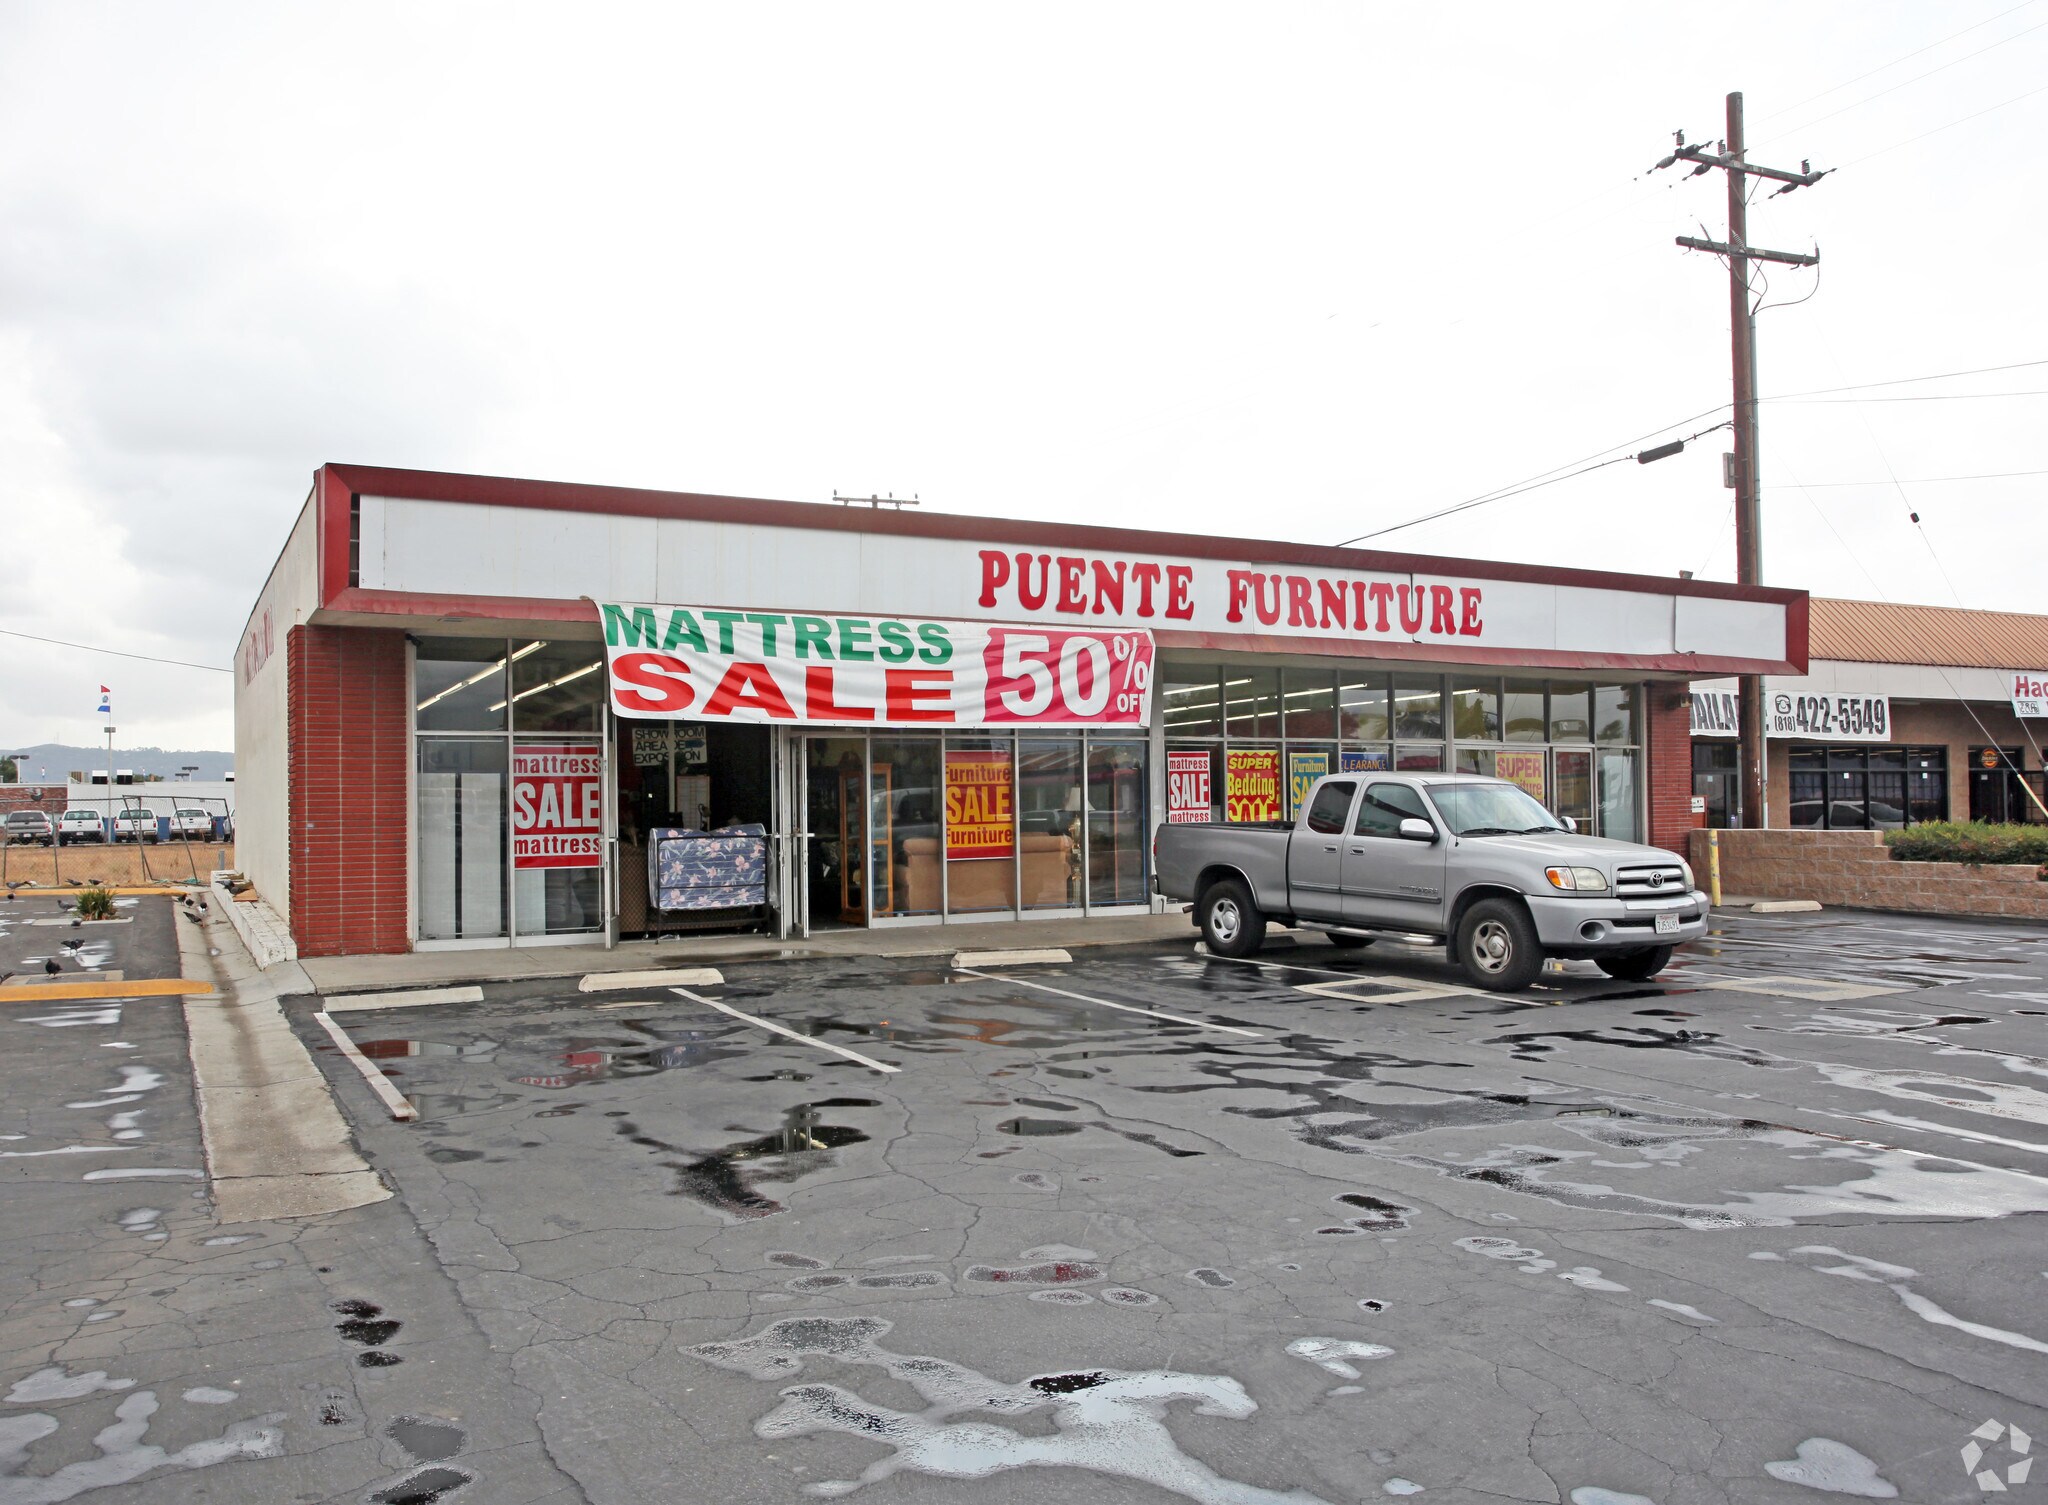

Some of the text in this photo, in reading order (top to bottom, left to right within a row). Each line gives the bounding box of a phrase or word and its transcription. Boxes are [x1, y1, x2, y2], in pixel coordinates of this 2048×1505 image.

[978, 550, 1482, 637] PUENTE FURNITURE
[602, 604, 954, 664] MATTRESS
[612, 653, 955, 722] SALE
[1774, 696, 1886, 735] (818) 422-5549
[636, 741, 668, 751] AREA
[513, 756, 601, 773] mattress
[1169, 759, 1208, 770] mattress
[1228, 757, 1272, 770] SUPER
[1294, 758, 1325, 773] Furniture
[1497, 757, 1542, 778] SUPER
[1170, 773, 1209, 809] SALE
[1227, 772, 1275, 801] Bedding
[514, 782, 601, 829] SALE
[946, 785, 1012, 824] SALE
[1170, 812, 1210, 823] mattress
[514, 836, 602, 854] mattress
